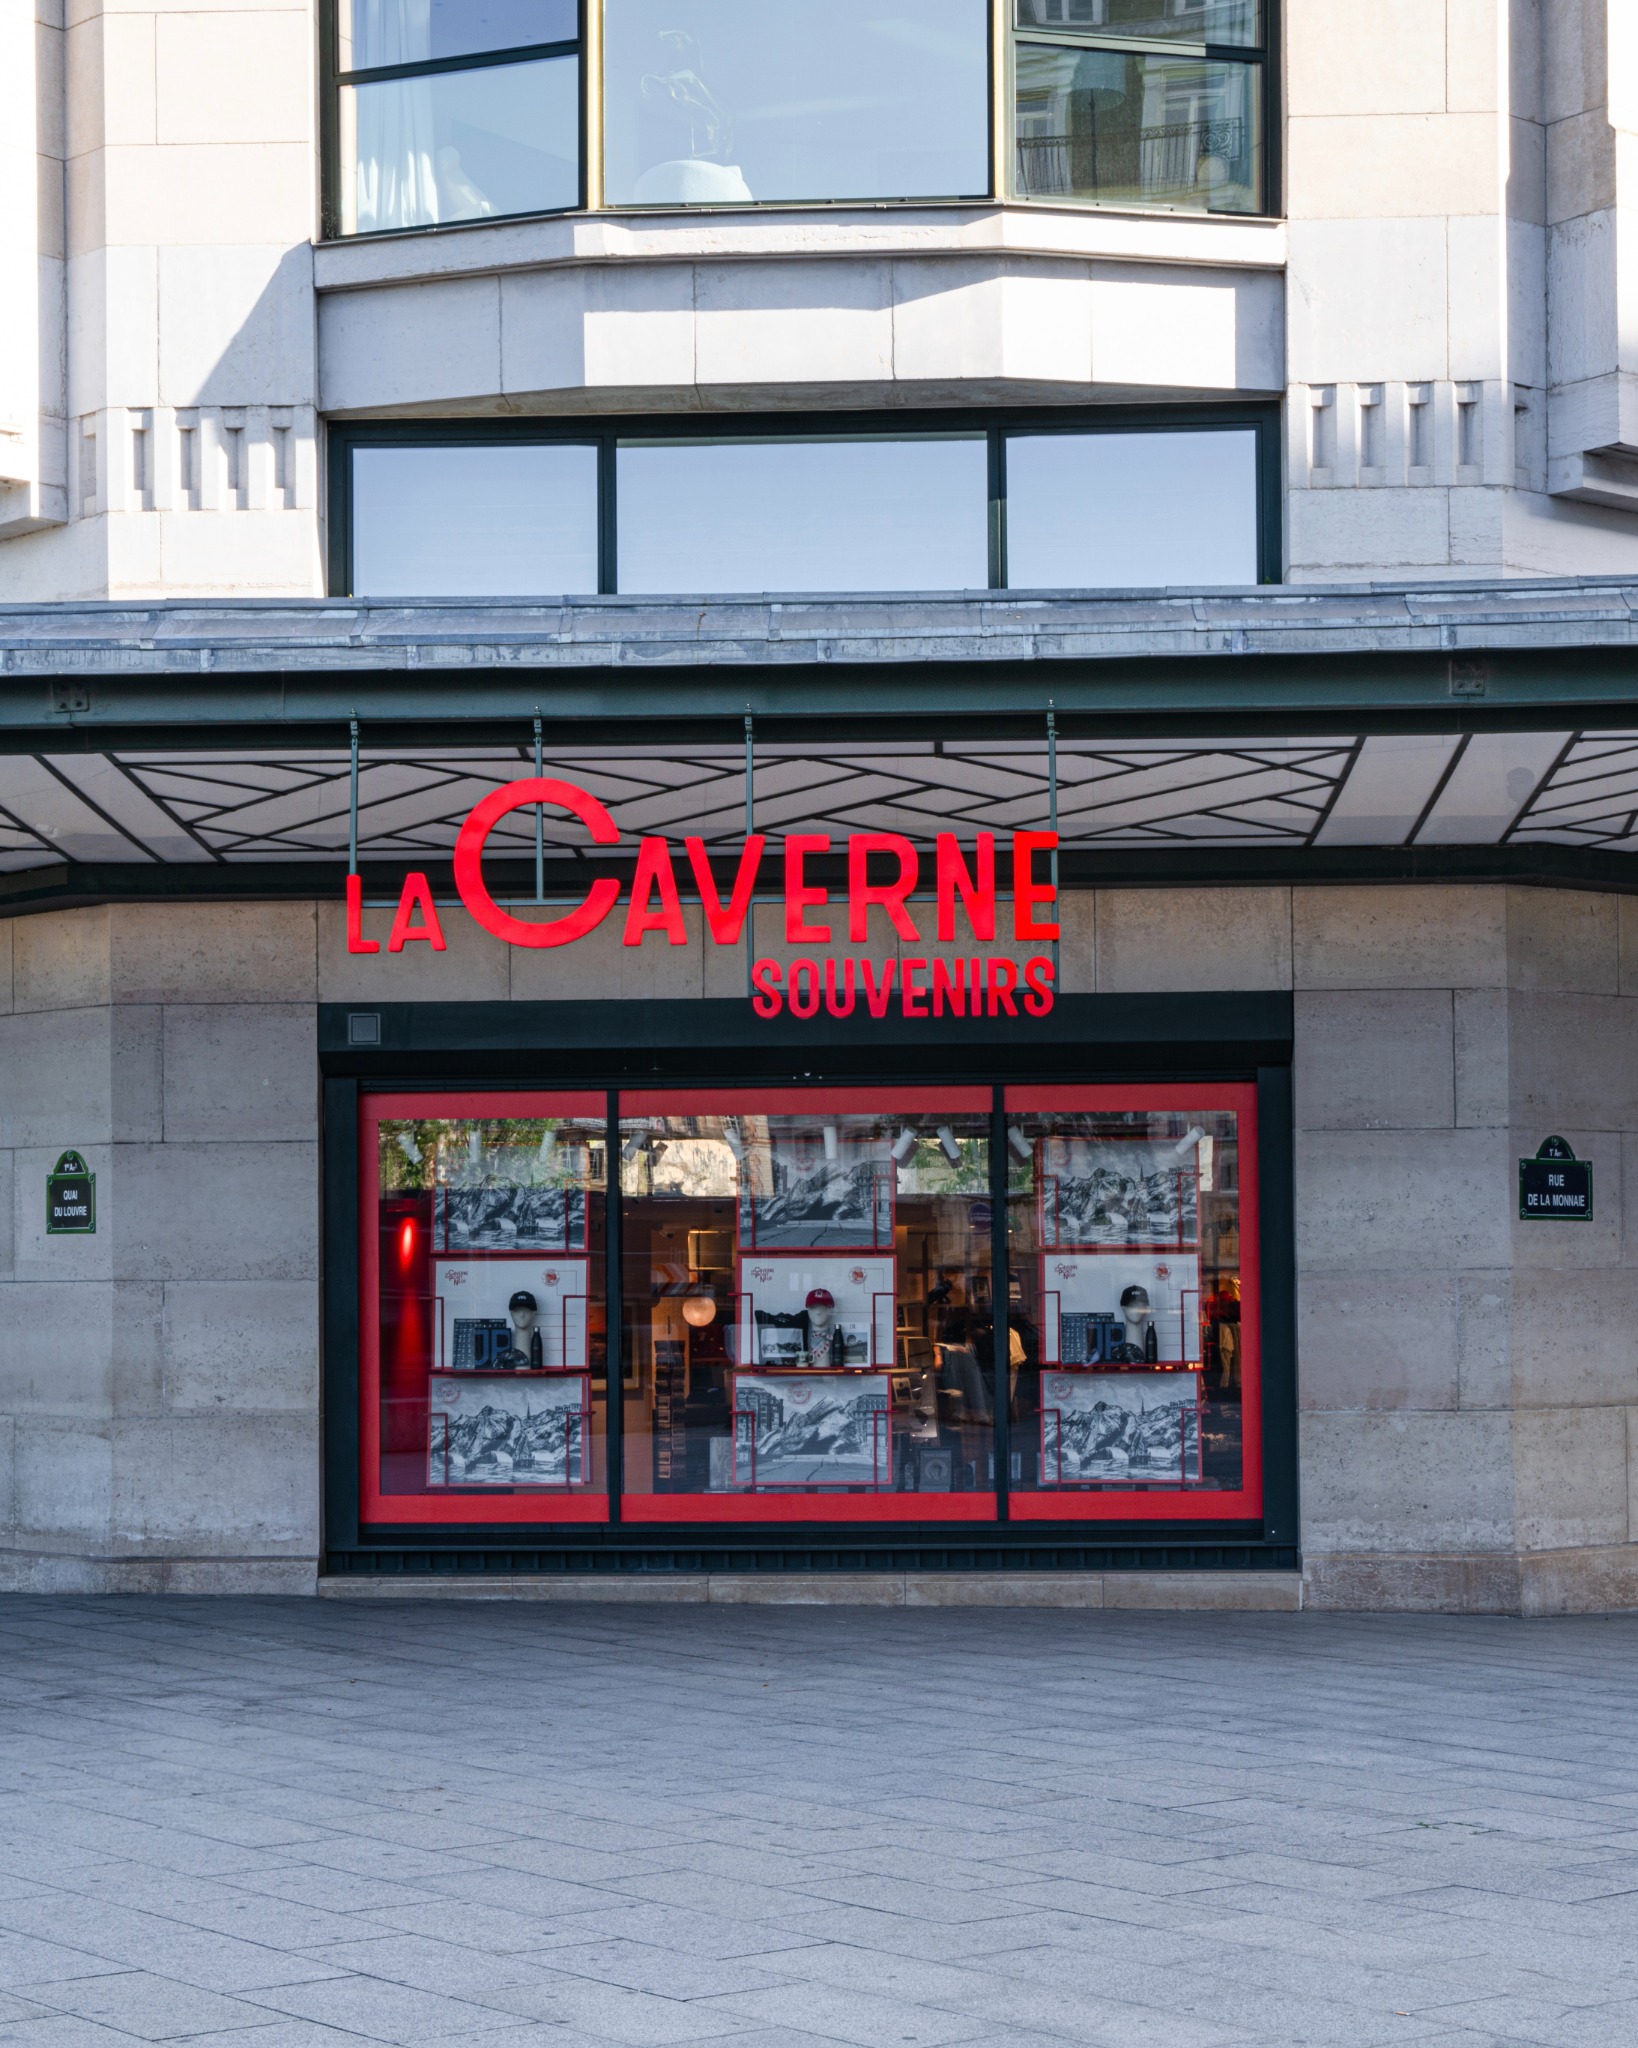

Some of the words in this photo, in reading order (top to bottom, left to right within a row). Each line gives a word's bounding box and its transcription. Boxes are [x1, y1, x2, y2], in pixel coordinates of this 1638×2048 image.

[347, 873, 446, 952] LA
[454, 778, 1060, 948] CAVERNE
[752, 956, 1054, 1017] SOUVENIRS
[1548, 1174, 1565, 1187] RUE
[63, 1190, 78, 1200] QUAI
[1527, 1193, 1539, 1206] DE
[1540, 1194, 1551, 1207] LA
[1552, 1195, 1585, 1207] MONNAIE
[54, 1207, 63, 1216] DU
[63, 1206, 87, 1216] LOUVRE
